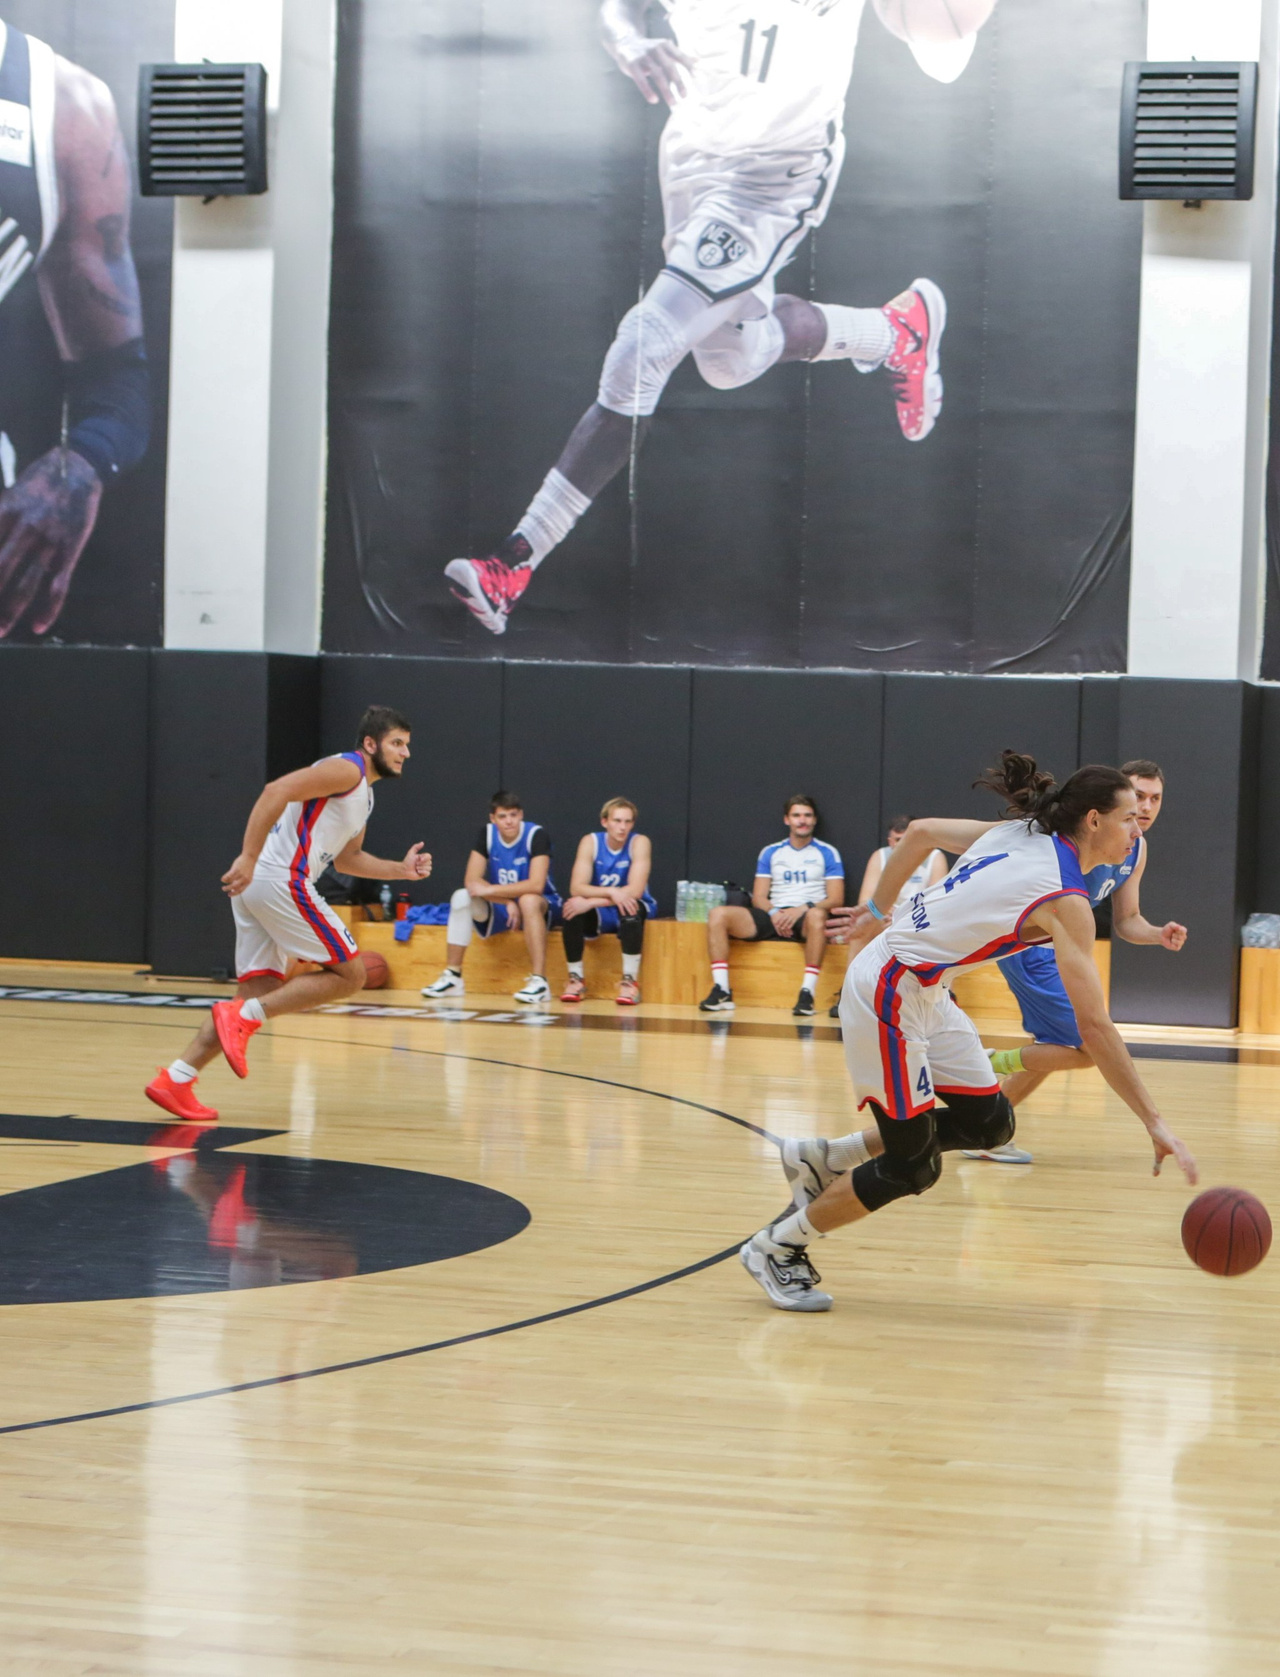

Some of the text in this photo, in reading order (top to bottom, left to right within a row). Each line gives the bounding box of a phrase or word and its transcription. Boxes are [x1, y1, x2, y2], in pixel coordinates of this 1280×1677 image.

[739, 18, 779, 84] 11
[703, 223, 748, 262] NETS
[783, 869, 807, 884] 911
[916, 1065, 932, 1097] 4
